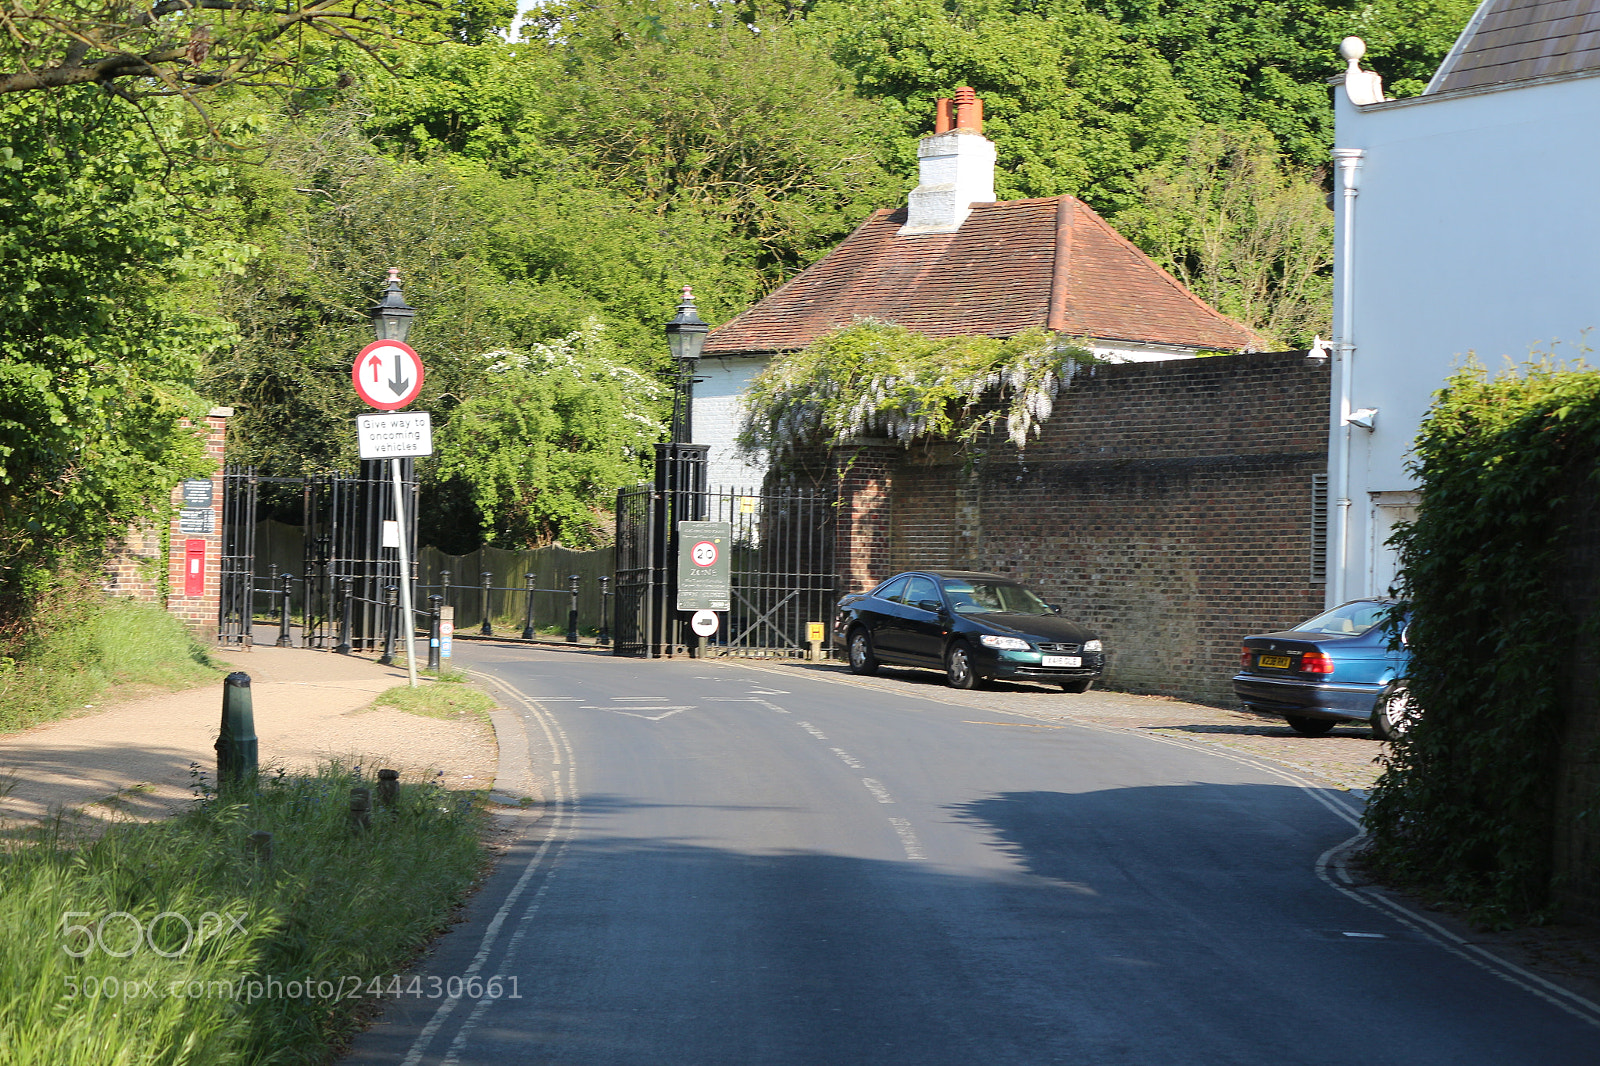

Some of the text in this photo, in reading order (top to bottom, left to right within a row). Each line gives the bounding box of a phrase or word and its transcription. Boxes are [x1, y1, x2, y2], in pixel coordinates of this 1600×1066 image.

[363, 418, 425, 429] Give way to
[370, 430, 420, 441] oncoming
[375, 442, 417, 452] vehicles
[697, 548, 714, 560] 20
[690, 568, 718, 577] ZONE
